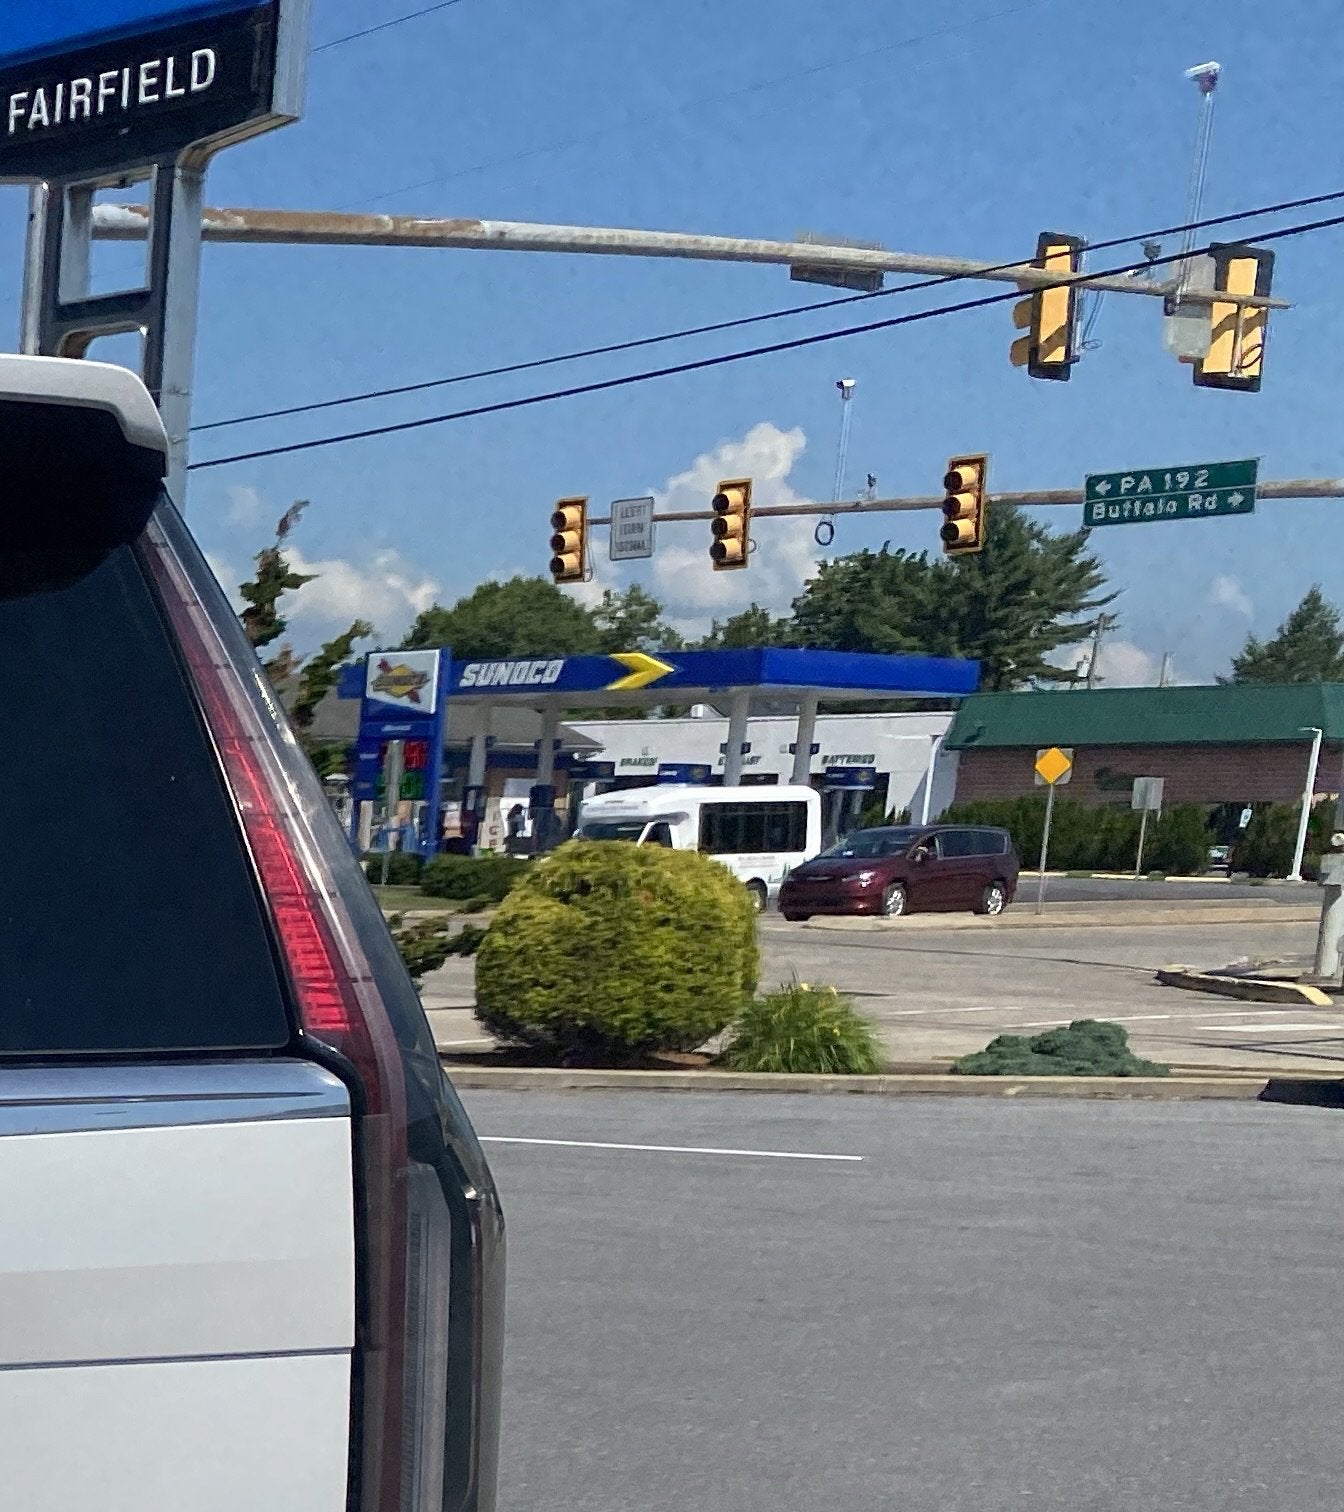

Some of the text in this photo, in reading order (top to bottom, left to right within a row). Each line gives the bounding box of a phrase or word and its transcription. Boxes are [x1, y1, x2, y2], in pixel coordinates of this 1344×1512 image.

[8, 48, 216, 135] FAIRFIELD
[1121, 469, 1209, 494] PA 192
[1092, 493, 1218, 520] Buffalo Rd
[460, 659, 564, 688] SUNOCO
